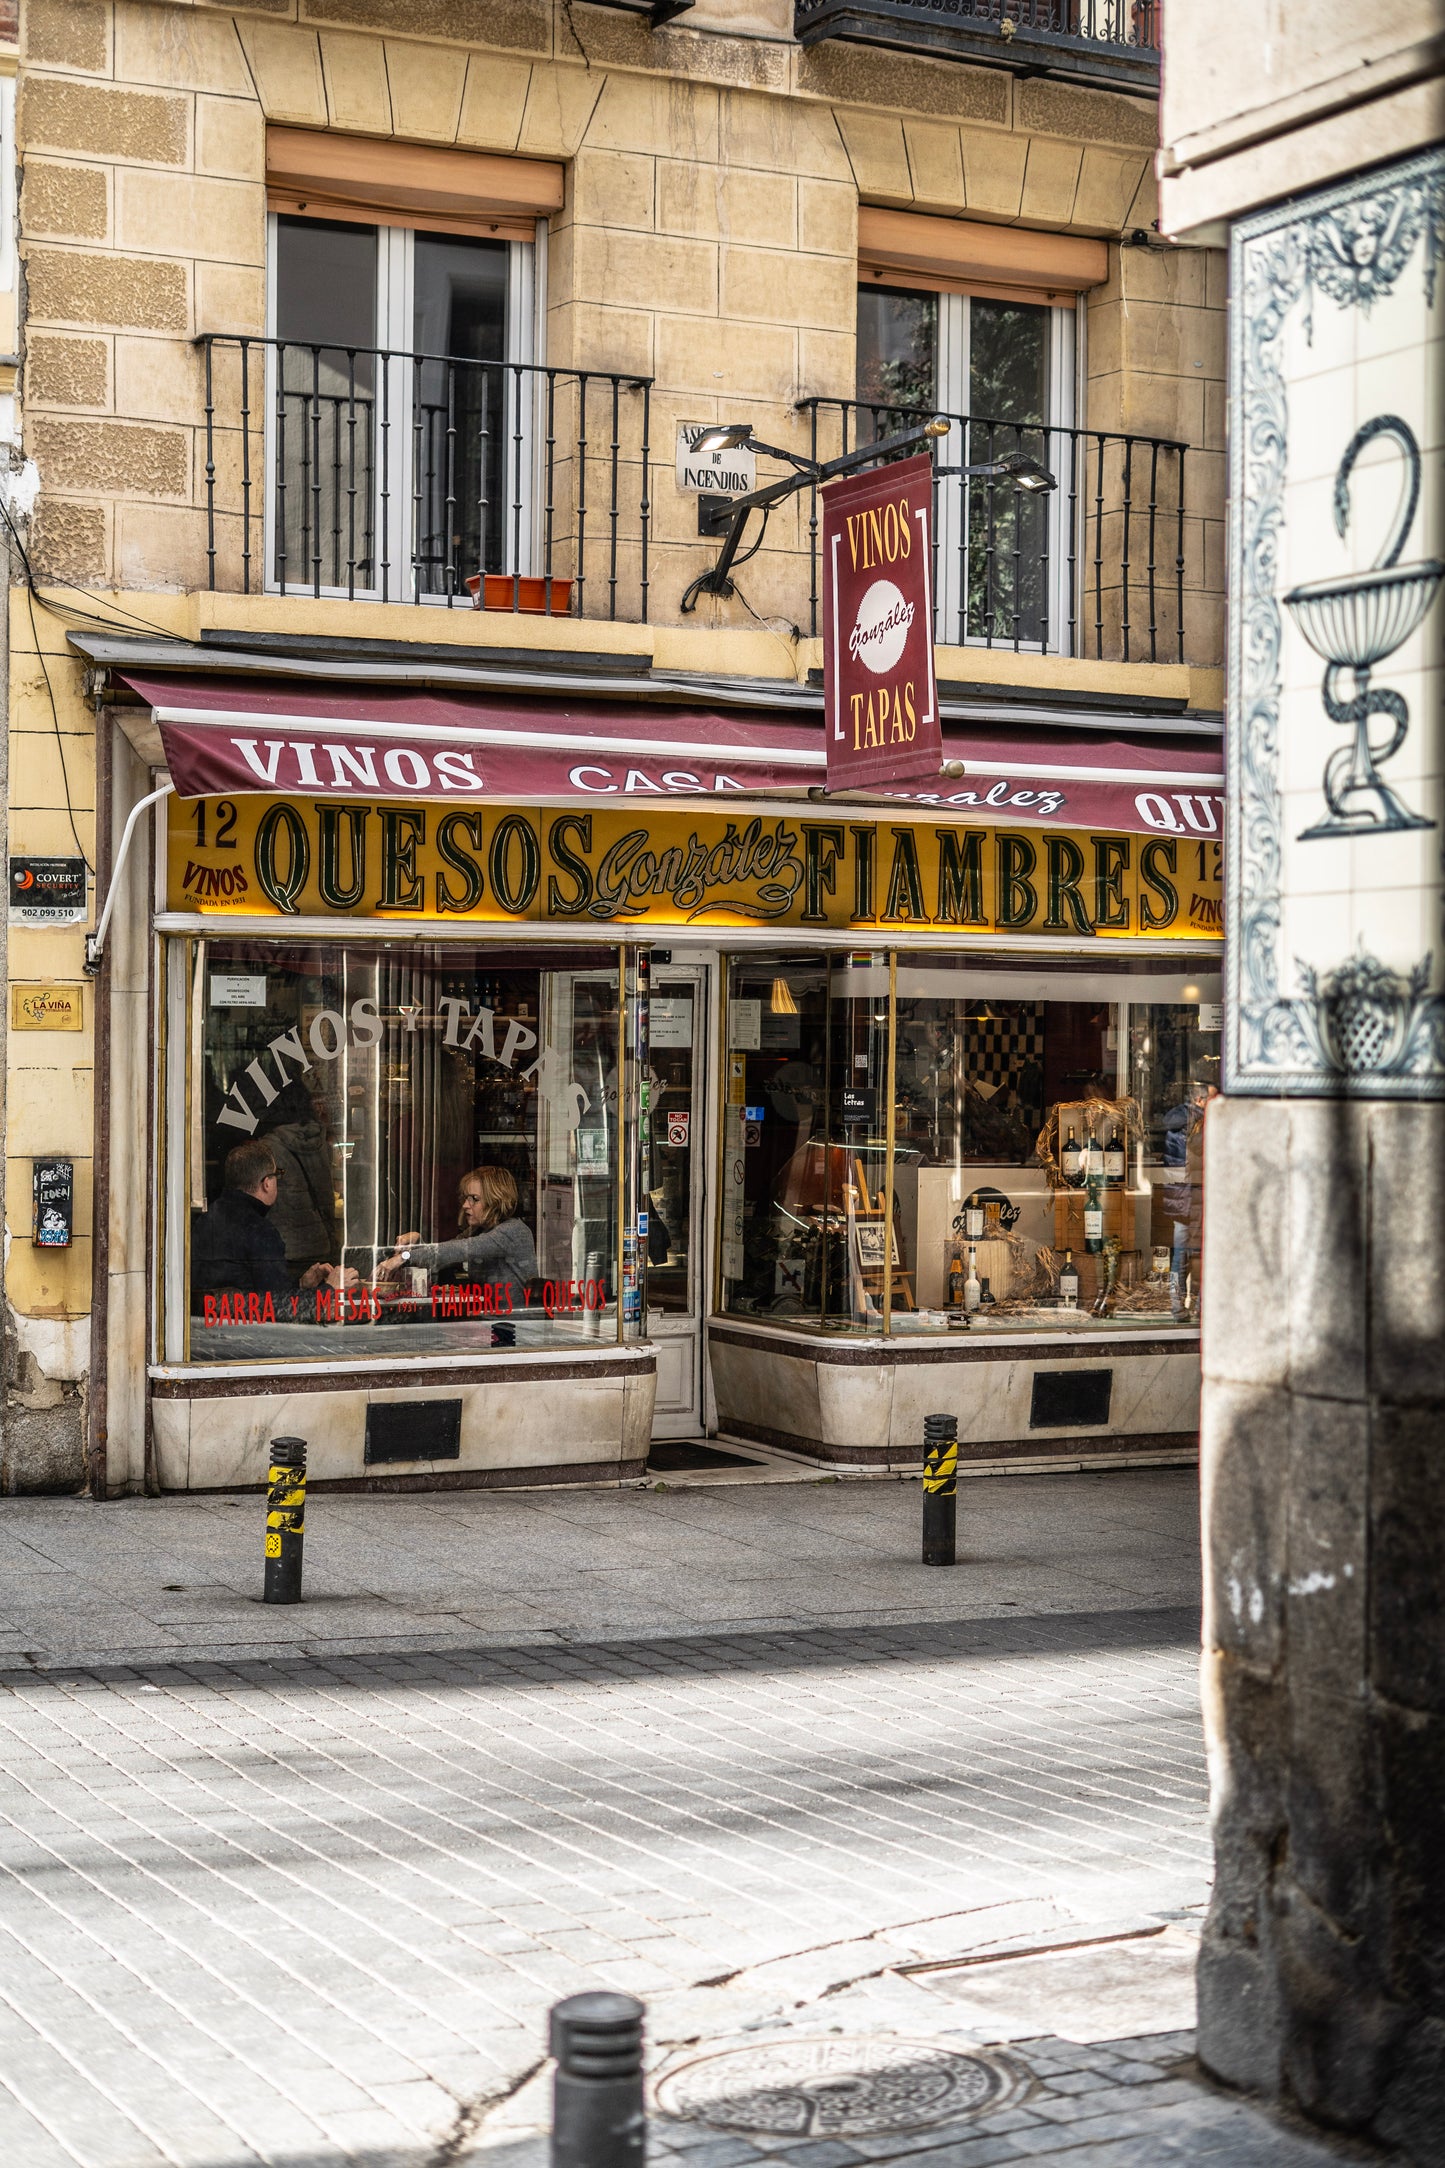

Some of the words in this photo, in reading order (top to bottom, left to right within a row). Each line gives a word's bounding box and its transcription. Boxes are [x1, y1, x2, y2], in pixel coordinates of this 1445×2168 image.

[712, 453, 721, 464] DE
[846, 498, 911, 573] VINOS
[849, 602, 915, 662] González
[850, 681, 916, 751] TAPAS
[230, 738, 484, 790] VINOS
[568, 765, 745, 792] CASA
[191, 799, 238, 848] 12
[1134, 792, 1226, 833] QU
[36, 873, 79, 883] COVERT
[182, 860, 249, 897] VINOS
[254, 802, 593, 915] QUESOS
[587, 817, 804, 923] González
[801, 823, 1178, 936] FIAMBRES
[22, 908, 37, 917] 902
[40, 908, 55, 917] 099
[58, 908, 73, 917] 510
[184, 894, 218, 906] FUNDADA
[220, 899, 231, 907] EN
[232, 897, 246, 906] 1931
[34, 1001, 46, 1009] LA
[48, 1000, 71, 1009] VIÑA
[216, 998, 383, 1136] VINOS
[399, 1007, 422, 1031] Y
[437, 996, 592, 1131] TAPAS
[204, 1291, 276, 1328] BARRA
[290, 1295, 299, 1317] Y
[316, 1287, 383, 1322] MESAS
[397, 1300, 417, 1313] 1931
[431, 1282, 513, 1318] FIAMBRES
[523, 1287, 532, 1309] Y
[543, 1278, 607, 1319] QUESOS
